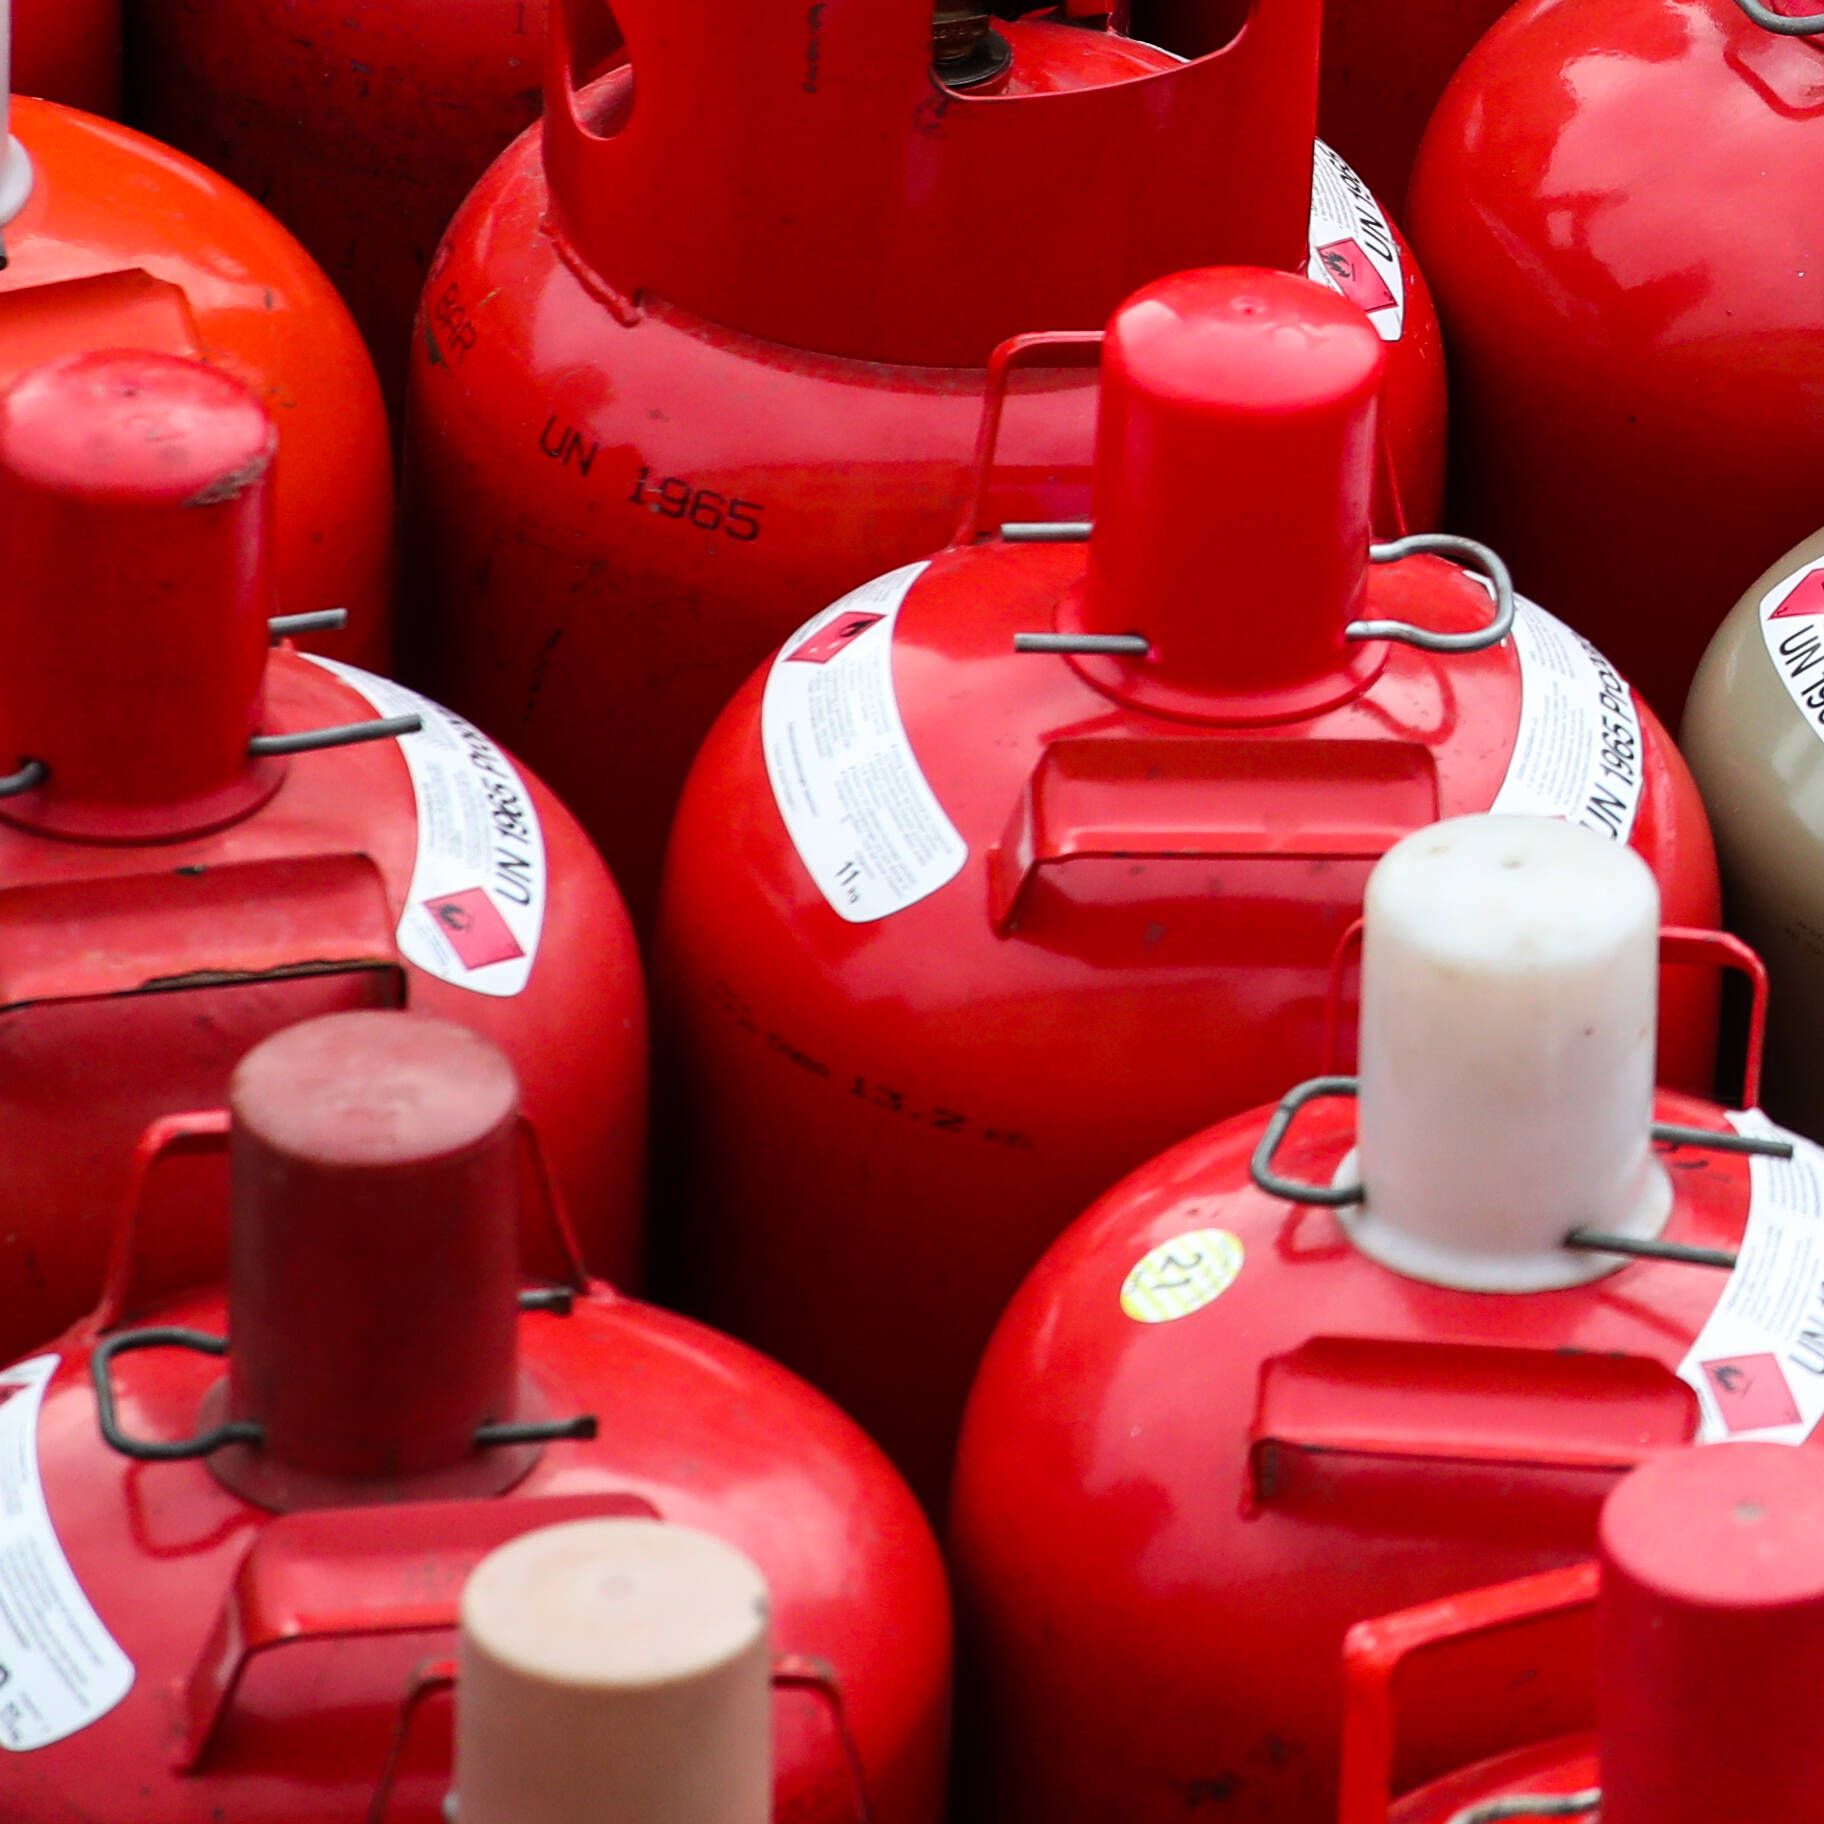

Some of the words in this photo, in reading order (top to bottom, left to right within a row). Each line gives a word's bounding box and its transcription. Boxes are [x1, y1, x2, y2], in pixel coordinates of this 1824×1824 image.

[1357, 207, 1394, 263] UN
[538, 413, 600, 477] UN
[625, 463, 767, 544] 1965
[1779, 626, 1821, 680] UN
[1599, 716, 1635, 787] 1965
[495, 847, 531, 906] UN
[848, 1074, 969, 1133] 13.2
